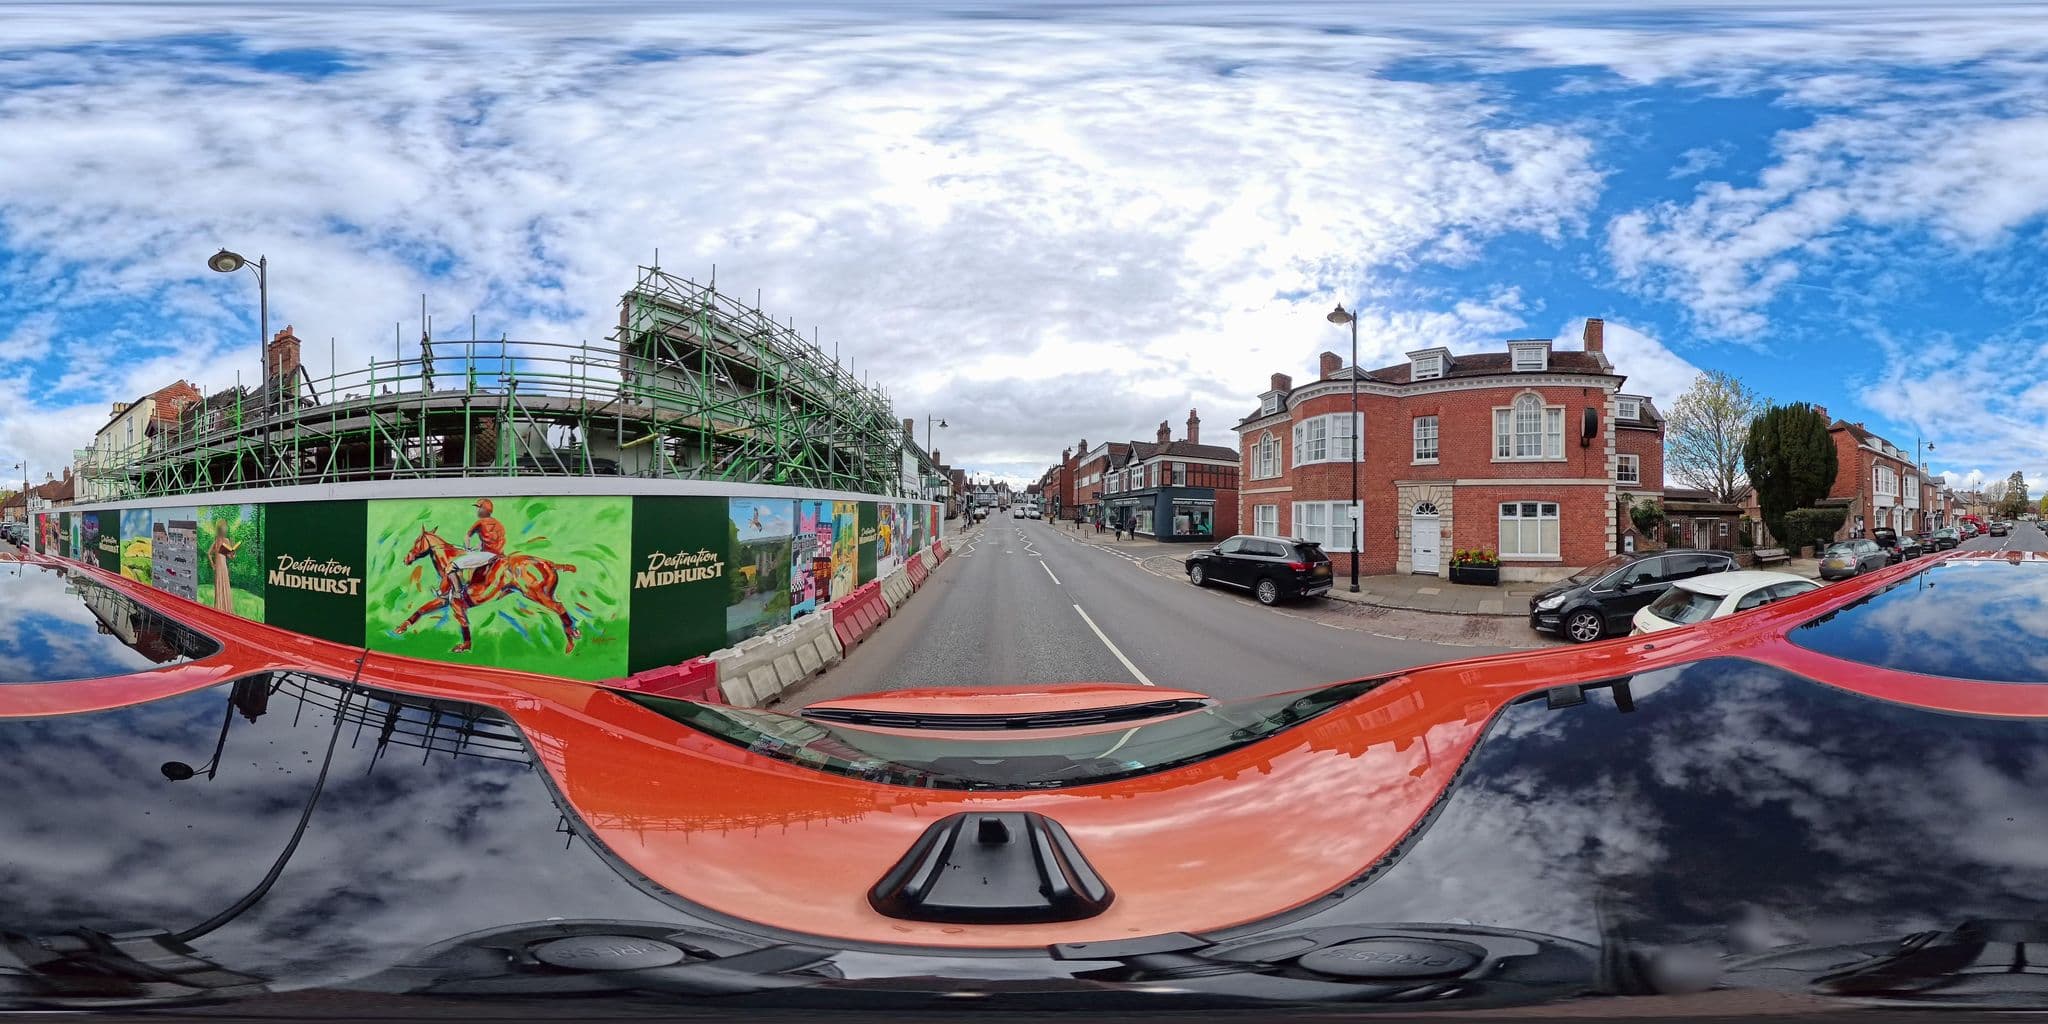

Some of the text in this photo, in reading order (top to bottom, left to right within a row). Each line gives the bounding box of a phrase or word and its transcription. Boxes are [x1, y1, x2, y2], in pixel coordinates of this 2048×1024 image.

[277, 553, 351, 576] Destination
[647, 547, 718, 571] Destination
[268, 569, 361, 595] MIDHURST
[634, 561, 725, 589] MIDHURST
